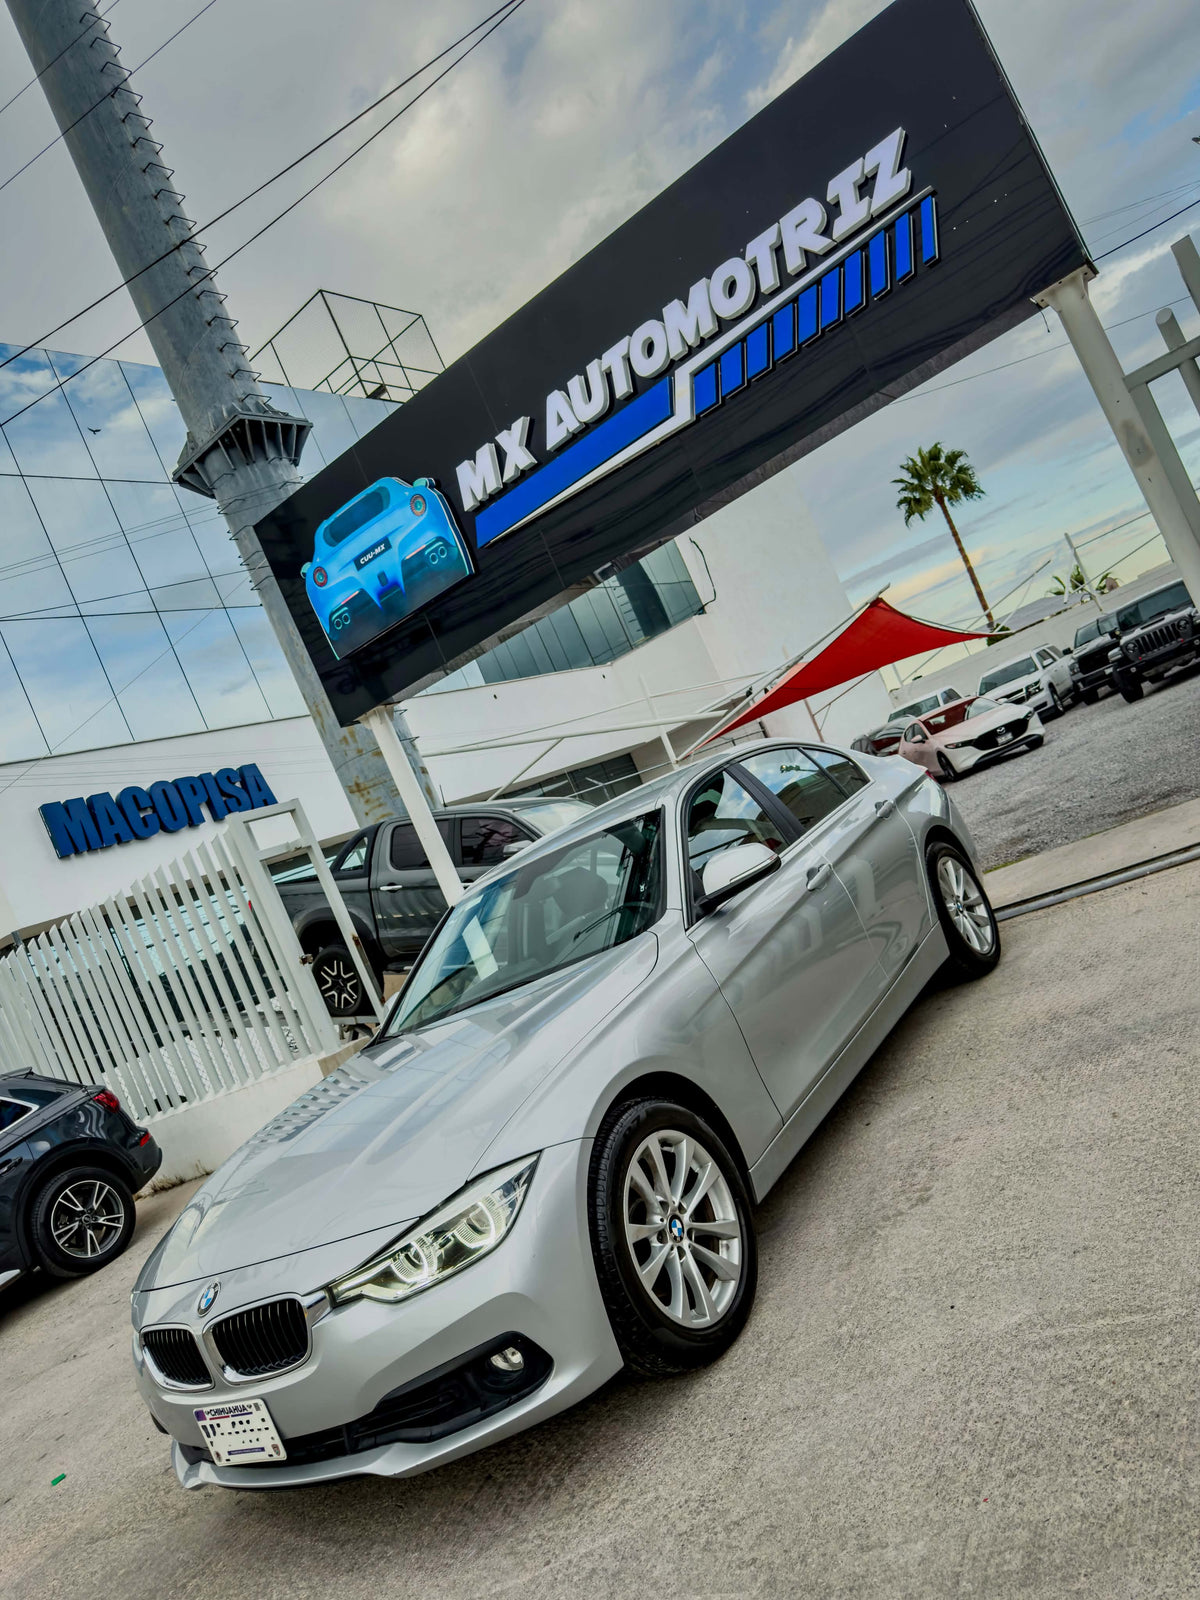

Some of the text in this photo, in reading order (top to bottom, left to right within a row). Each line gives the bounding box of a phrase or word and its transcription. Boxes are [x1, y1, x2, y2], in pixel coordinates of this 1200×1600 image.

[456, 127, 911, 511] MX AUTOMOTRIZ
[360, 543, 385, 564] CUU-MX
[40, 764, 278, 858] MACOPISA
[209, 1404, 248, 1417] CHIHUAHUA
